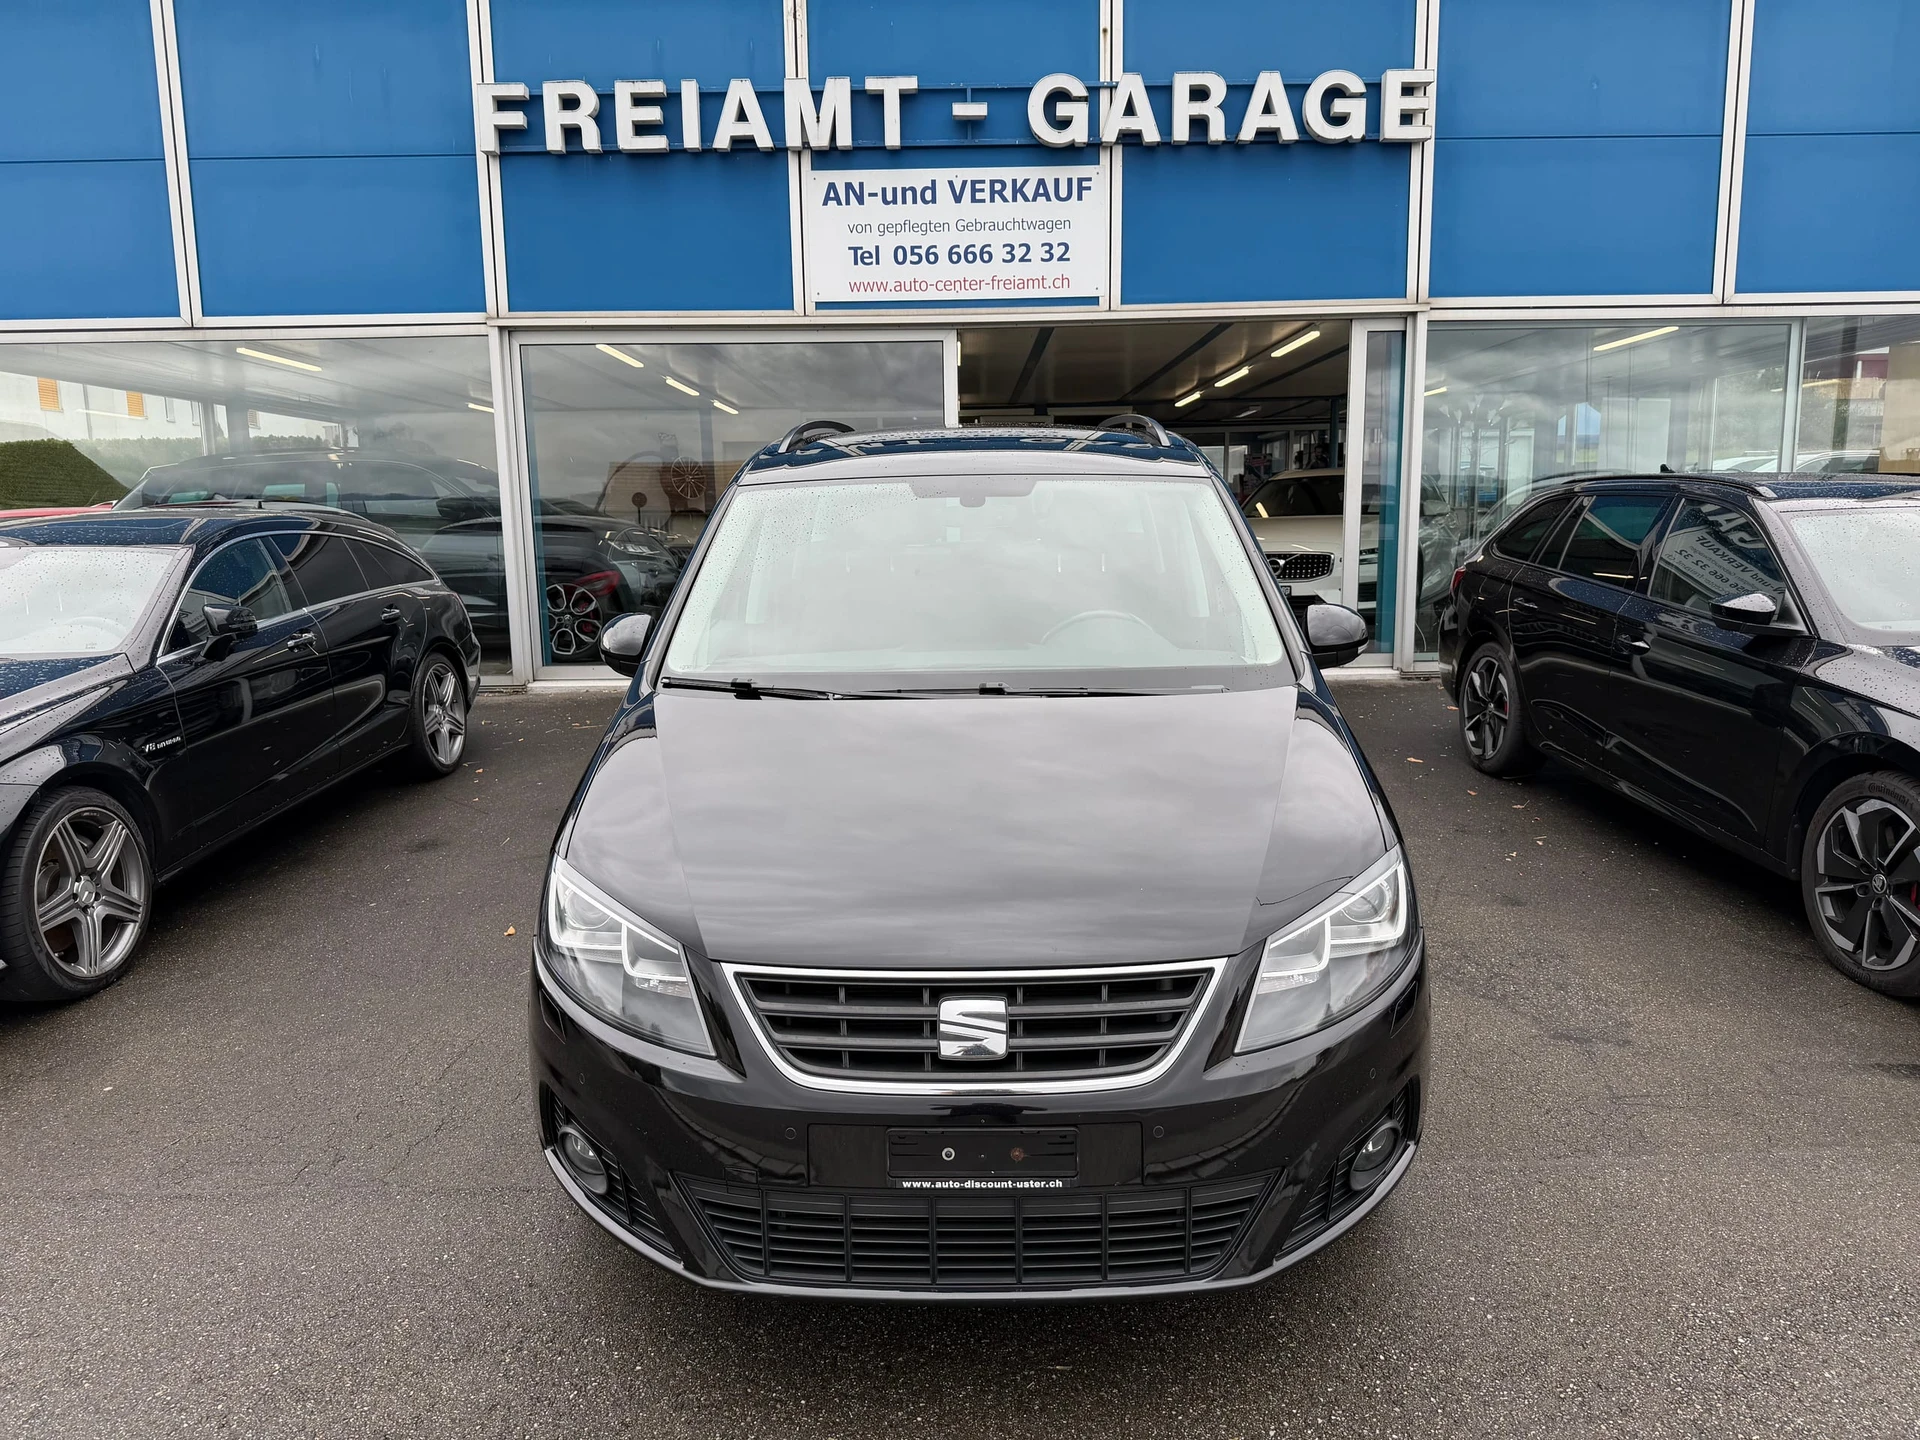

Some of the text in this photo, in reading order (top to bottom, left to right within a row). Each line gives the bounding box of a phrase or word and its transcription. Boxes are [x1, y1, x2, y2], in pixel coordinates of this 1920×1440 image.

[477, 75, 918, 155] FREIAMT
[1027, 69, 1435, 148] GARAGE
[822, 177, 1093, 207] AN-und VERKAUF
[848, 217, 1071, 236] von gepflegten Gebrauchtwagen
[848, 241, 1071, 266] Tel 056 666 32 32
[849, 274, 1071, 293] www.auto-center-freiamt.ch
[902, 1179, 1063, 1189] www.auto-discount-uster.ch
